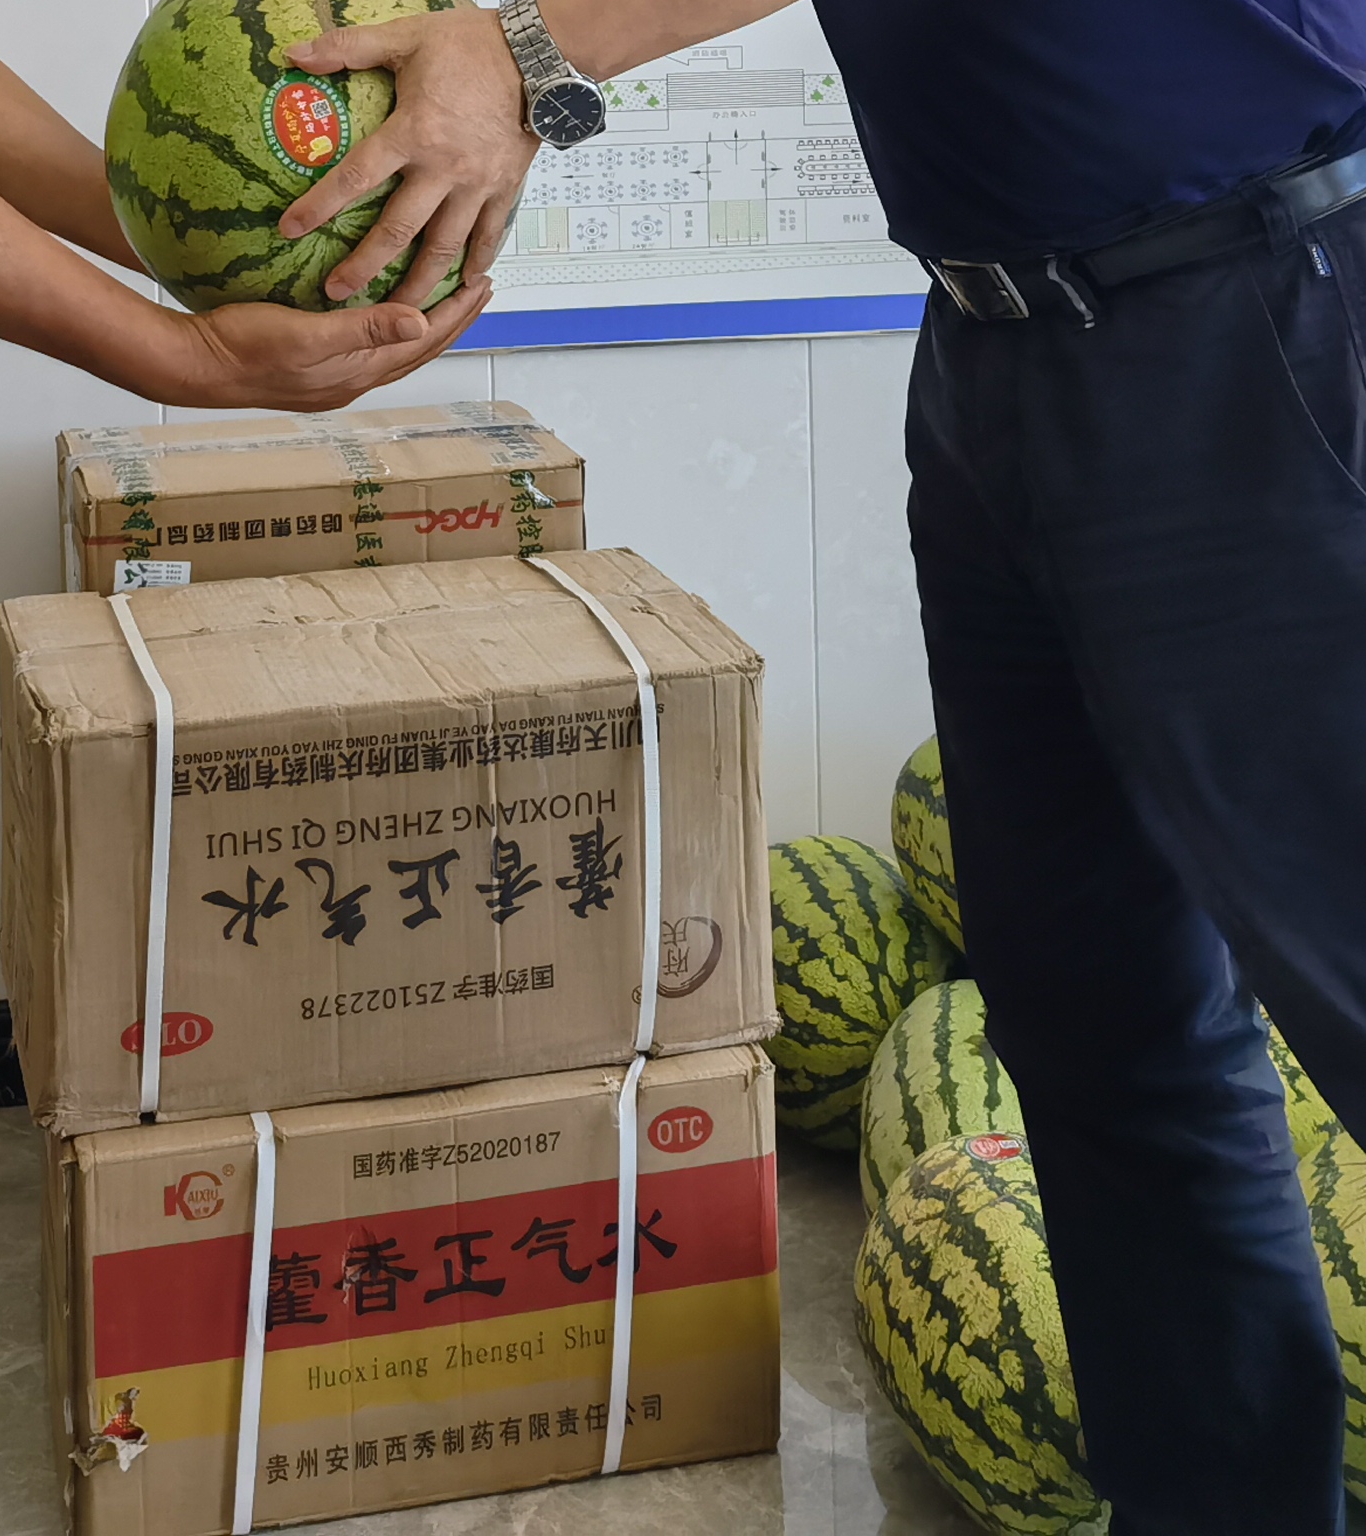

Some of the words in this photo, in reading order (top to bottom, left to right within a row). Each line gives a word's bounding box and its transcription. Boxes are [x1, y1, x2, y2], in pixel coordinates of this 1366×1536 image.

[153, 512, 343, 548] 哈药集团制药总厂
[519, 715, 556, 731] KANG
[556, 713, 574, 728] FU
[575, 709, 605, 724] TIAN
[438, 726, 451, 740] JI
[452, 723, 469, 738] YE
[471, 721, 498, 737] YAO
[499, 719, 517, 734] DA
[346, 733, 380, 750] QING
[381, 731, 398, 746] FU
[400, 728, 437, 744] TUAN
[260, 743, 290, 759] YOU
[291, 740, 320, 756] YAO
[322, 737, 344, 753] ZHI
[183, 750, 223, 766] GONG
[225, 746, 259, 763] XIAN
[452, 789, 617, 832] HUOXIANG
[290, 816, 327, 851] QI
[335, 807, 445, 846] ZHENG
[206, 821, 283, 859] SHUI
[201, 817, 625, 947] 藿香正气水
[661, 917, 691, 978] 府庆
[453, 965, 555, 1002] 国药准字
[300, 978, 444, 1020] Z51022378
[656, 1116, 704, 1145] OTC
[352, 1131, 562, 1180] 国药准字Z52020187
[264, 1208, 679, 1332] 藿香正气水
[306, 1353, 429, 1391] Huoxiang
[444, 1331, 545, 1371] Zhengqi
[564, 1324, 613, 1351] Shu
